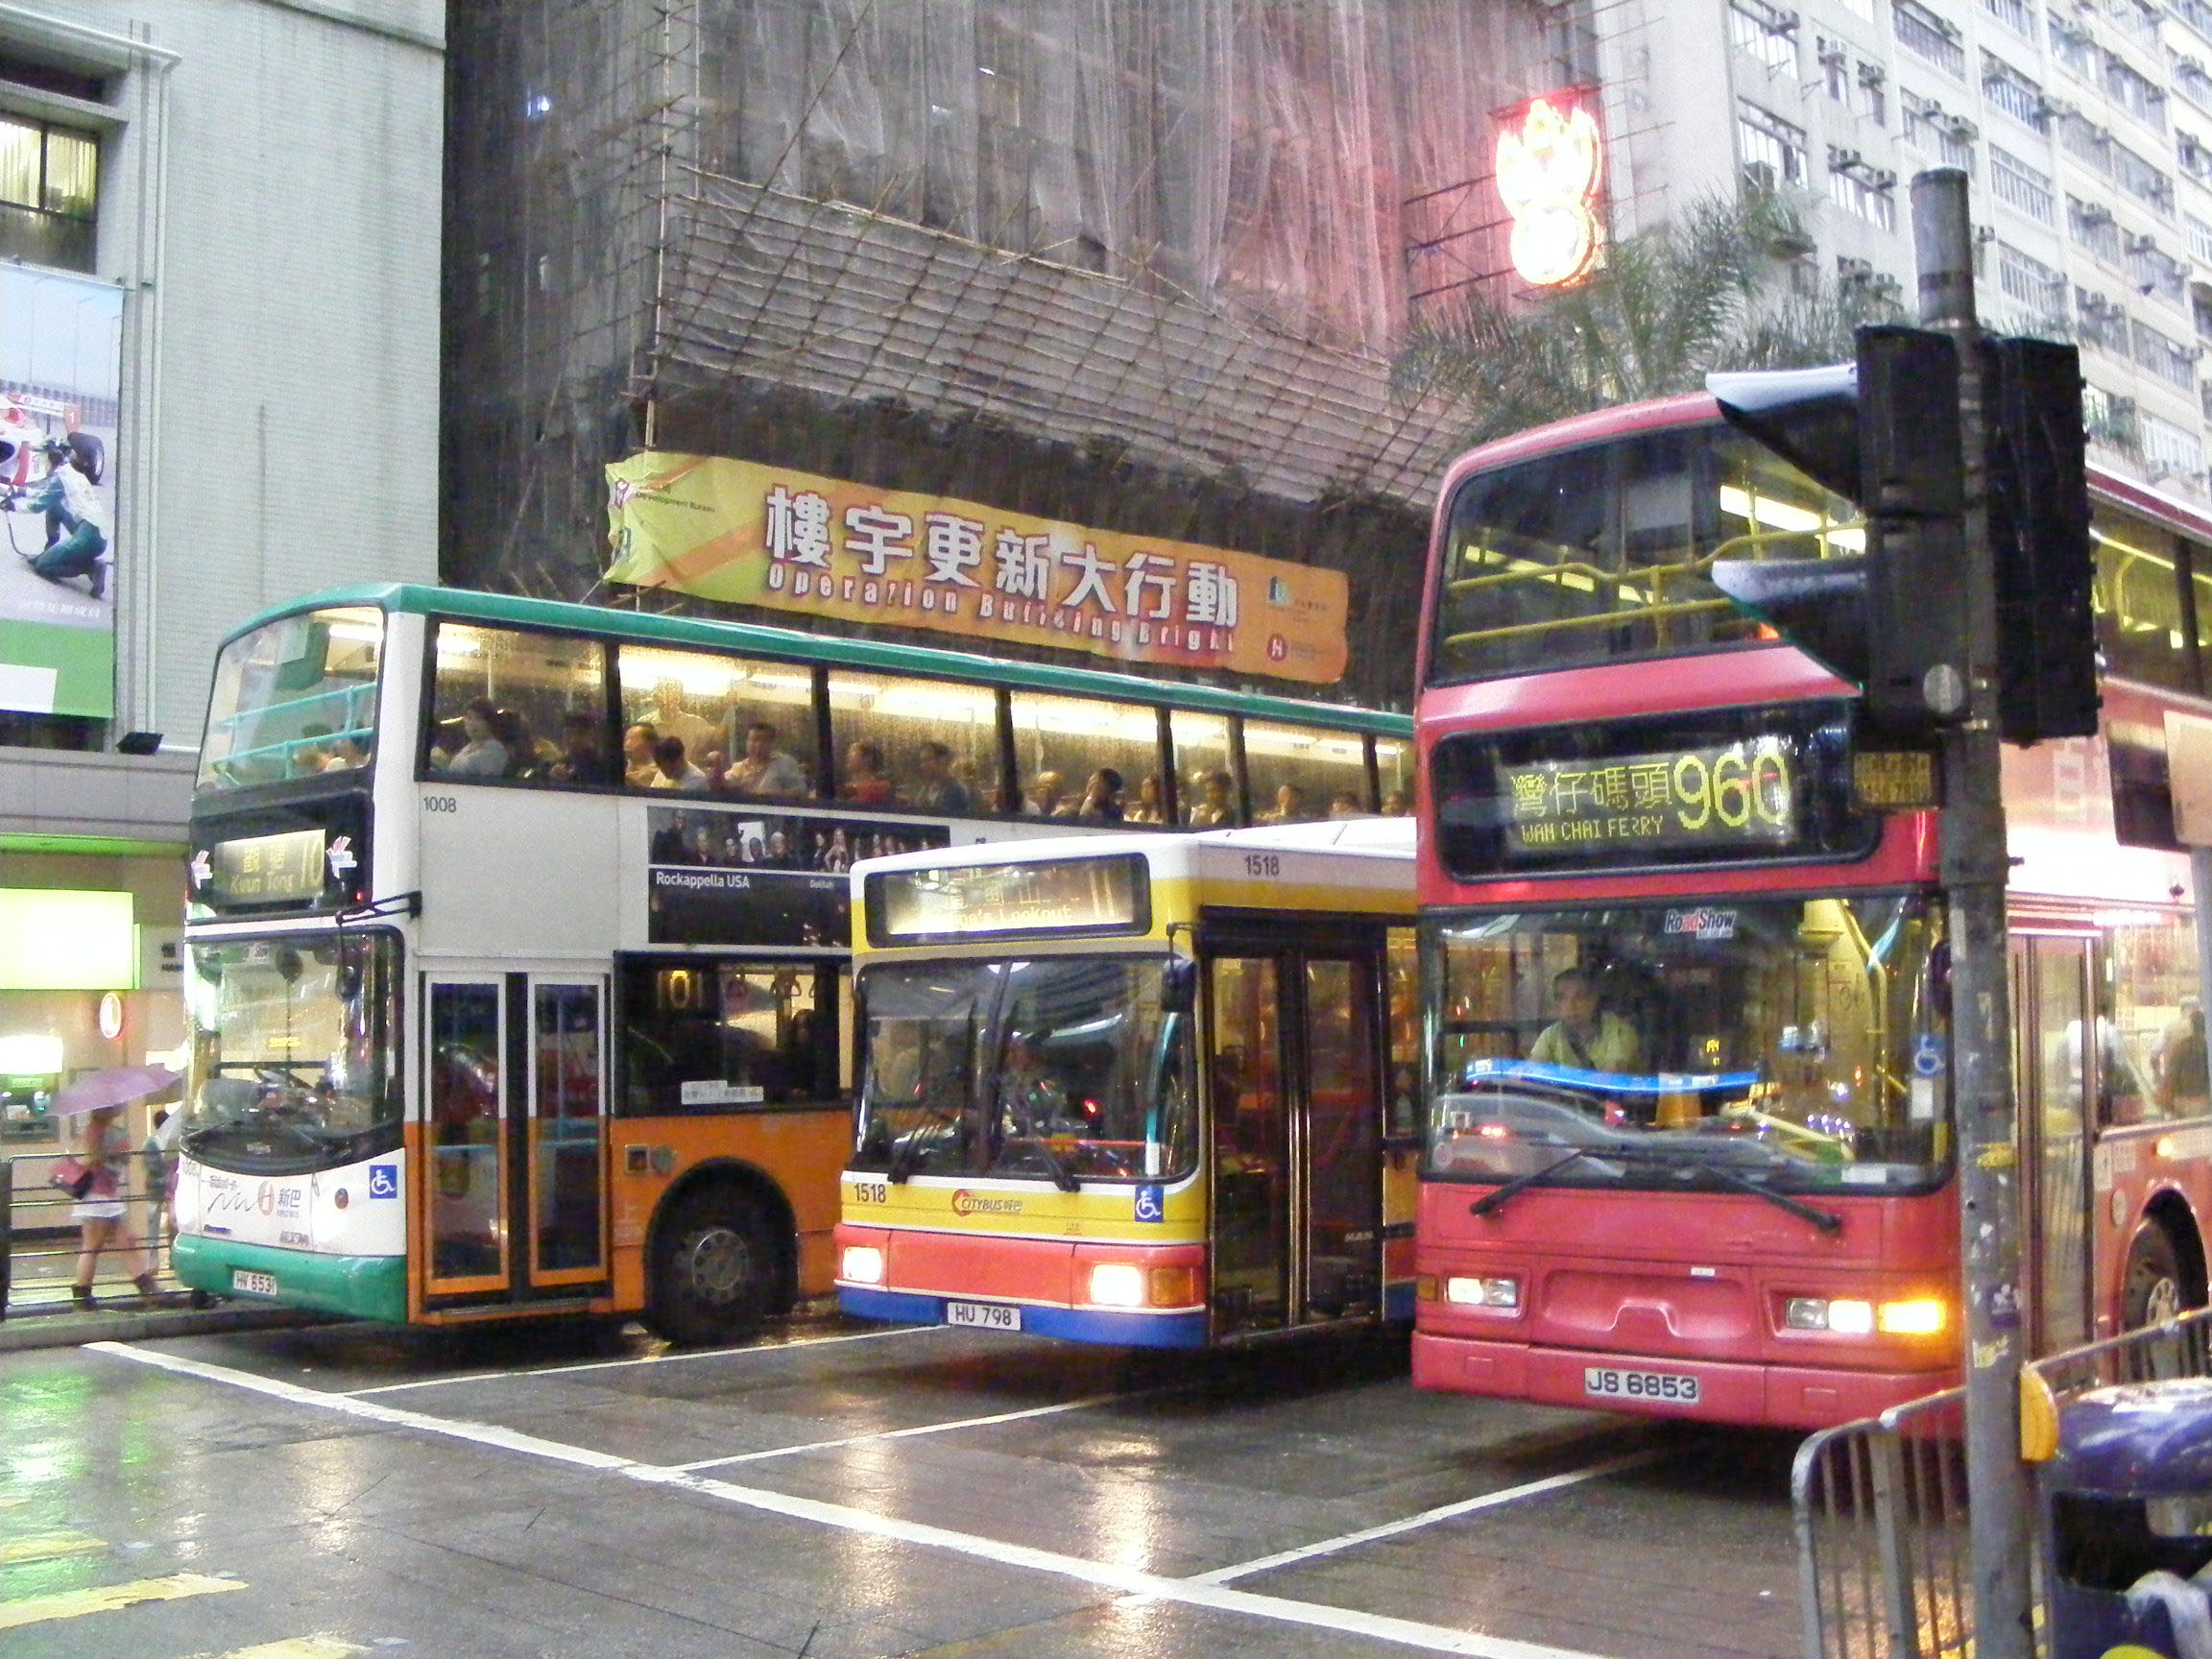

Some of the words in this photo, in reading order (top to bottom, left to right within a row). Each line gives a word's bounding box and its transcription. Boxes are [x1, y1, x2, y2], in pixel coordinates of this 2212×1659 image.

[766, 486, 1238, 628] 樓宇更新大行動
[768, 563, 958, 613] Operation
[1139, 620, 1235, 653] Bright
[1512, 761, 1672, 816] 灣仔碼頭
[1673, 754, 1790, 830] 960
[422, 796, 458, 814] 1008
[1521, 823, 1555, 843] WAN
[1560, 818, 1601, 841] CHAI
[1607, 814, 1665, 838] FERRY
[1243, 854, 1281, 877] 1518
[656, 870, 725, 889] Rockappella
[727, 875, 751, 889] USA
[277, 1188, 301, 1208] 新巴
[854, 1182, 887, 1205] 1518
[961, 1197, 1003, 1211] CITYBUS
[954, 1305, 975, 1323] HU
[982, 1307, 1013, 1327] 798
[1626, 1373, 1697, 1400] 6853
